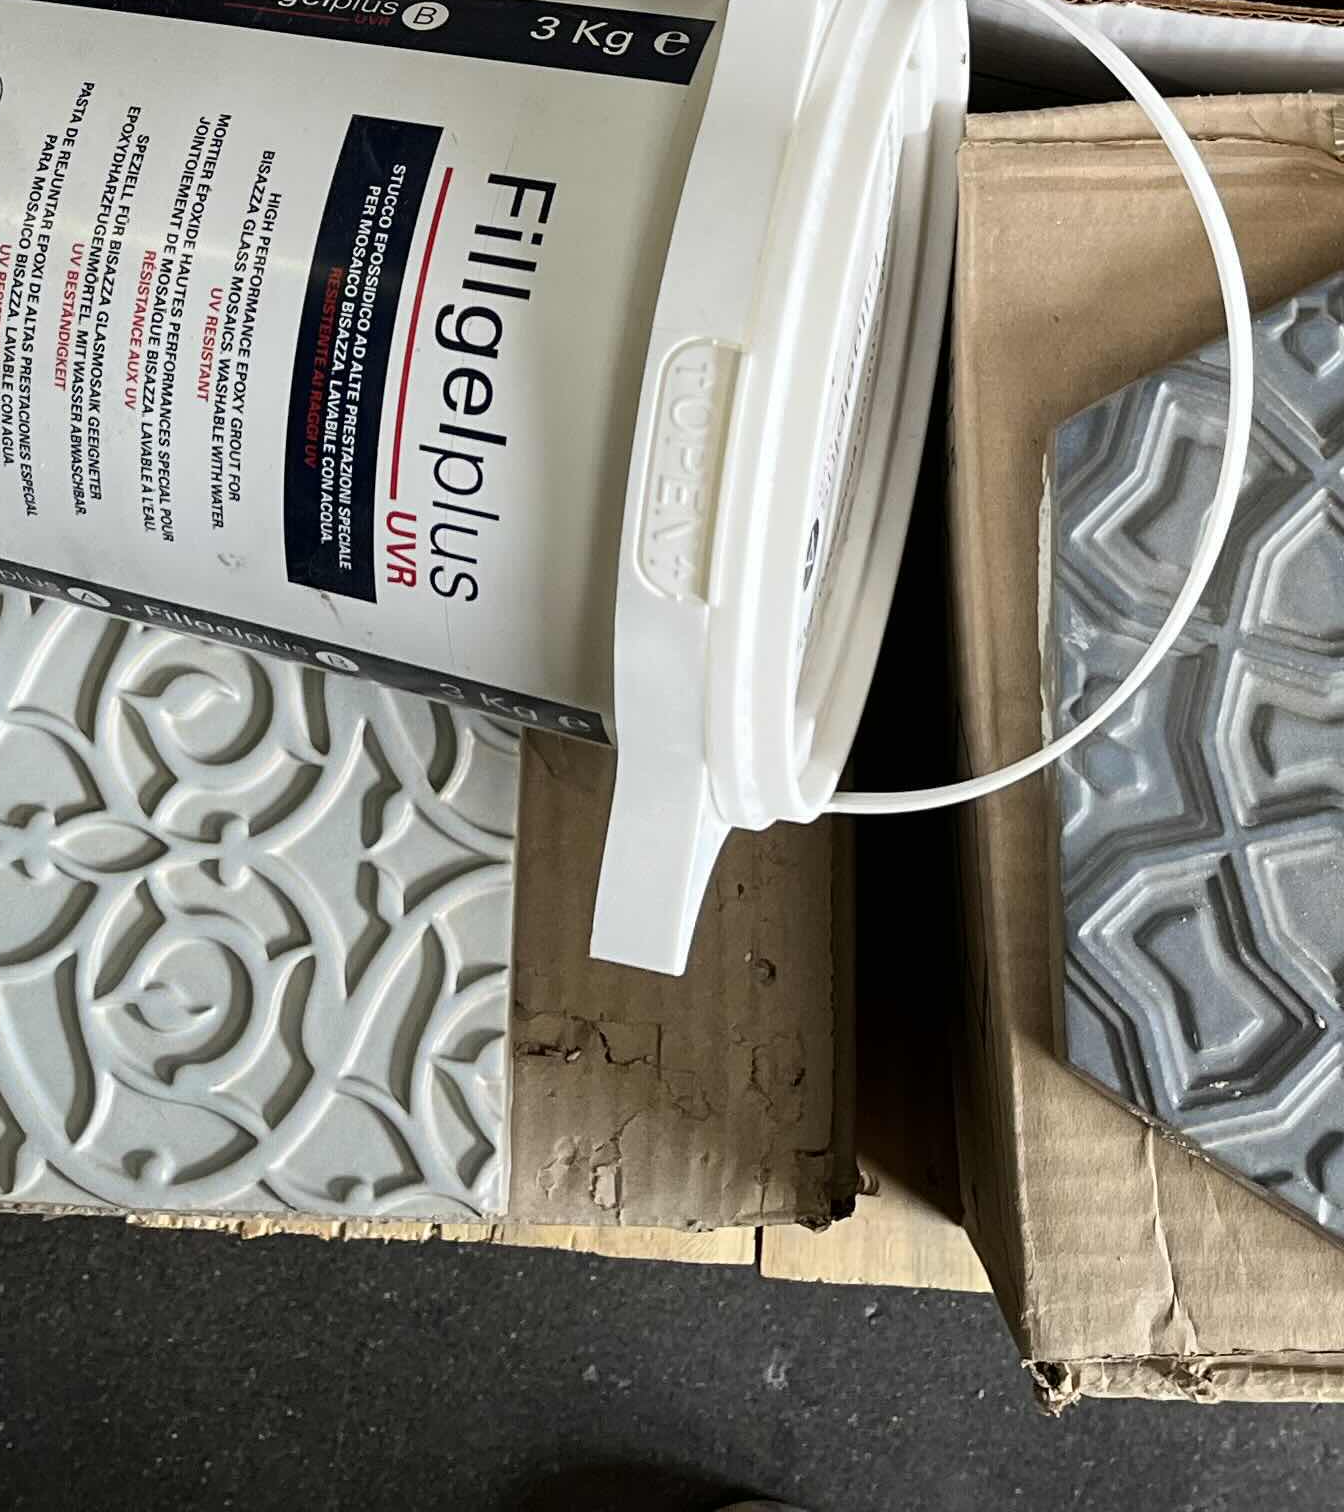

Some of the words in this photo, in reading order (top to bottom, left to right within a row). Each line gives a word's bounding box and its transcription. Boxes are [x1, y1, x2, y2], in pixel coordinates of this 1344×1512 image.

[529, 16, 561, 41] 3
[571, 20, 634, 55] Kg
[69, 80, 94, 124] PASTA
[35, 134, 57, 172] PARA
[61, 126, 79, 147] DE
[119, 134, 149, 201] SPEZIELL
[200, 112, 230, 180] MORTIER
[40, 149, 71, 230] REJUNTAR
[169, 115, 210, 230] JOINTOIEMENT
[246, 149, 275, 215] BISAZZA
[361, 185, 380, 216] PER
[377, 163, 405, 229] STUCCO
[18, 175, 46, 250] MOSAICO
[77, 104, 140, 325] EPOXYDHARZFUGENMÖRTEL.
[110, 204, 129, 236] FÜR
[182, 182, 210, 249] ÉPOXIDE
[260, 192, 281, 232] HIGH
[29, 232, 51, 280] EPOXI
[68, 242, 83, 267] UV
[98, 239, 121, 305] BISAZZA
[163, 232, 180, 255] DE
[233, 218, 256, 272] GLASS
[343, 218, 372, 298] MOSAICO
[6, 253, 28, 322] BISAZZA.
[25, 282, 41, 303] DE
[129, 250, 156, 346] RÉSISTANCE
[147, 257, 174, 346] MOSAÏQUE
[169, 252, 193, 318] HAUTES
[207, 287, 222, 312] UV
[238, 235, 271, 358] PERFORMANCE
[355, 232, 388, 332] EPOSSIDICO
[21, 305, 37, 352] ALTAS
[53, 269, 79, 391] BESTÄNDIGKEIT
[74, 329, 89, 358] MIT
[219, 275, 244, 356] MOSAICS.
[330, 300, 354, 375] BISAZZA.
[351, 333, 367, 358] AD
[1, 326, 18, 390] LAVABLE
[88, 310, 109, 413] GLASMOSAIK
[125, 349, 140, 383] AUX
[141, 349, 159, 417] BISAZZA.
[157, 321, 180, 446] PERFORMANCES
[196, 315, 218, 402] RESISTANT
[231, 361, 249, 414] EPOXY
[346, 360, 363, 401] ALTE
[418, 173, 559, 603] Fillgelplus
[0, 393, 13, 424] CON
[18, 355, 32, 460] PRESTACIONES
[70, 360, 85, 421] WASSER
[123, 386, 136, 410] UV
[211, 357, 231, 443] WASHABLE
[322, 379, 341, 453] LAVABILE
[1, 426, 14, 467] AGUA.
[70, 424, 84, 516] ABWASCHBAR.
[87, 416, 101, 500] GEEIGNETER
[140, 421, 153, 482] LAVABLE
[210, 445, 223, 486] WITH
[228, 417, 243, 471] GROUT
[320, 456, 334, 493] CON
[339, 404, 358, 504] PRESTAZIONI
[19, 463, 37, 516] ESPECIAL
[140, 484, 152, 494] À
[157, 450, 170, 504] SPECIAL
[210, 484, 223, 530] WATER.
[227, 474, 240, 501] FOR
[140, 497, 154, 533] L'EAU.
[158, 507, 173, 542] POUR
[319, 492, 332, 544] ACQUA.
[338, 506, 351, 570] SPECIALE
[385, 510, 417, 588] UVR
[142, 603, 311, 657] Fillgelplus
[475, 690, 543, 721] Kg
